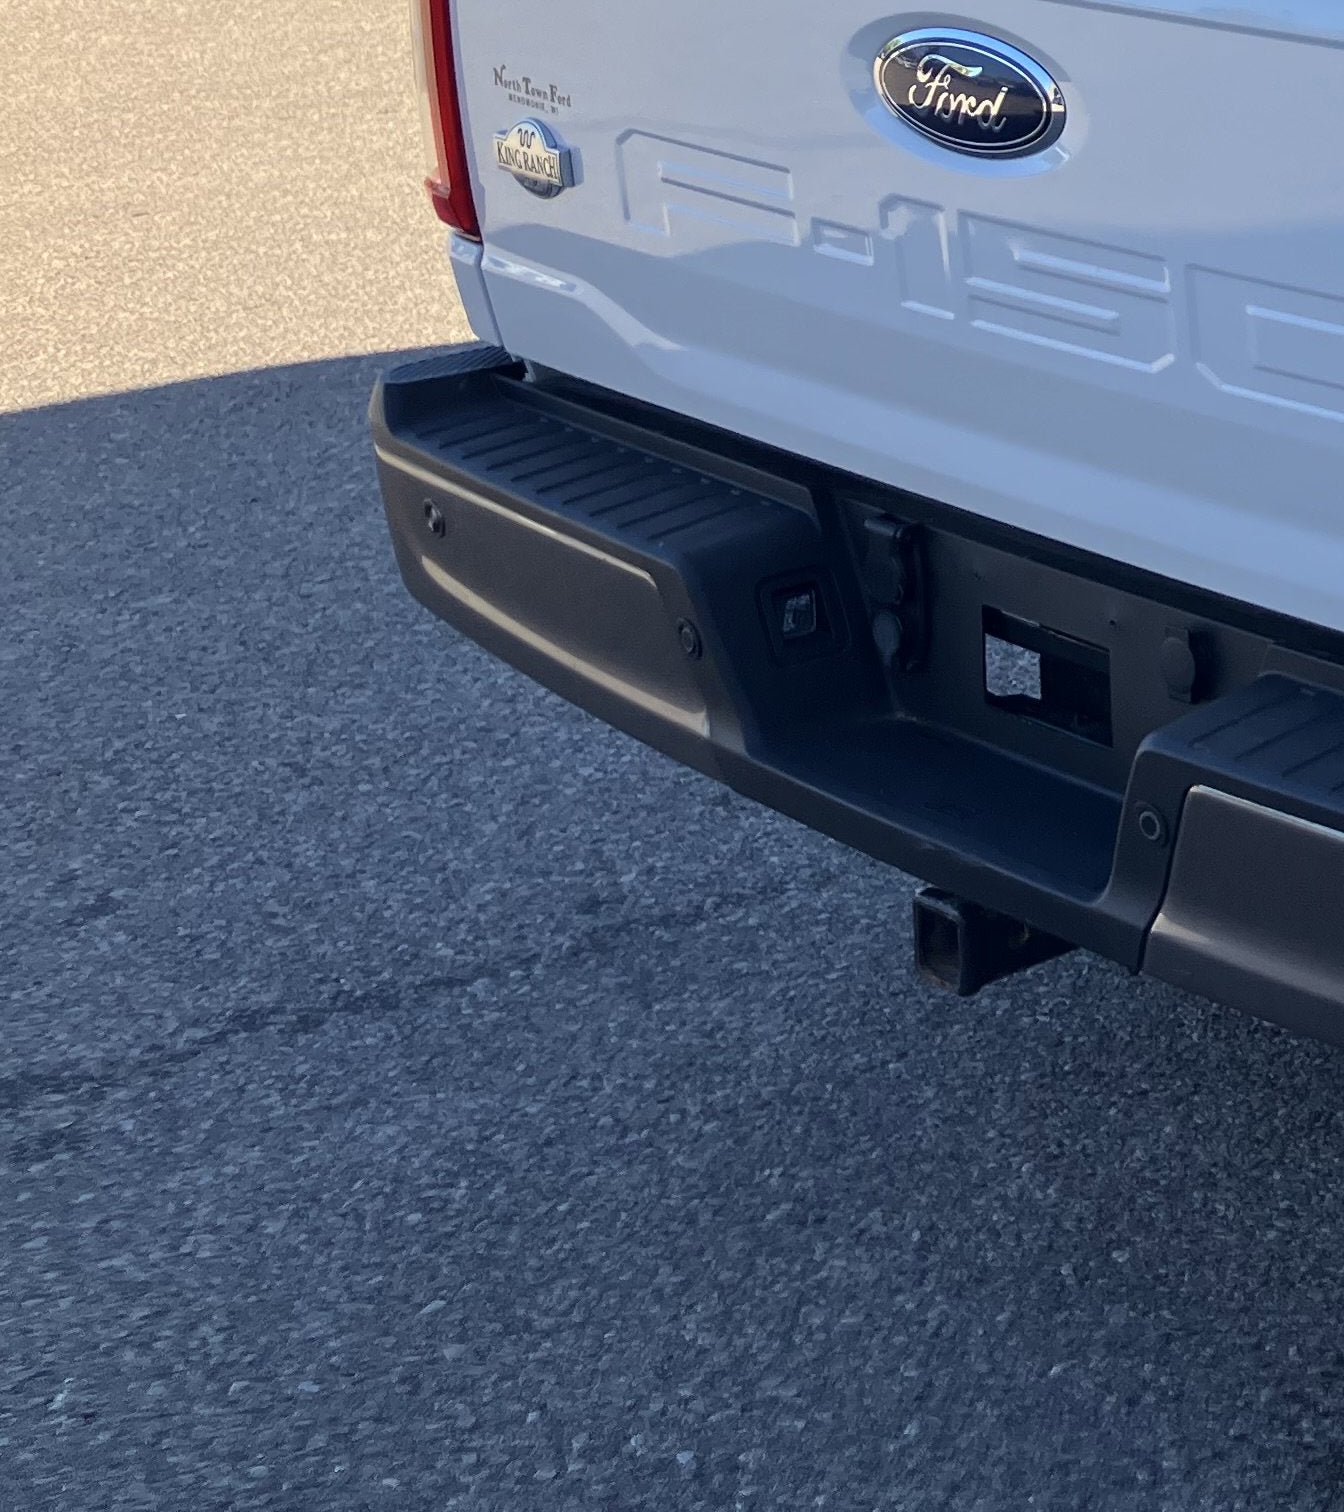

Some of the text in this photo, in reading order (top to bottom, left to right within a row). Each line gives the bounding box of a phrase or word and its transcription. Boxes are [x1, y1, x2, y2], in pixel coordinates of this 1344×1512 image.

[493, 64, 572, 108] North Town Ford
[908, 53, 1009, 133] Ford
[497, 141, 559, 180] KING RANCH
